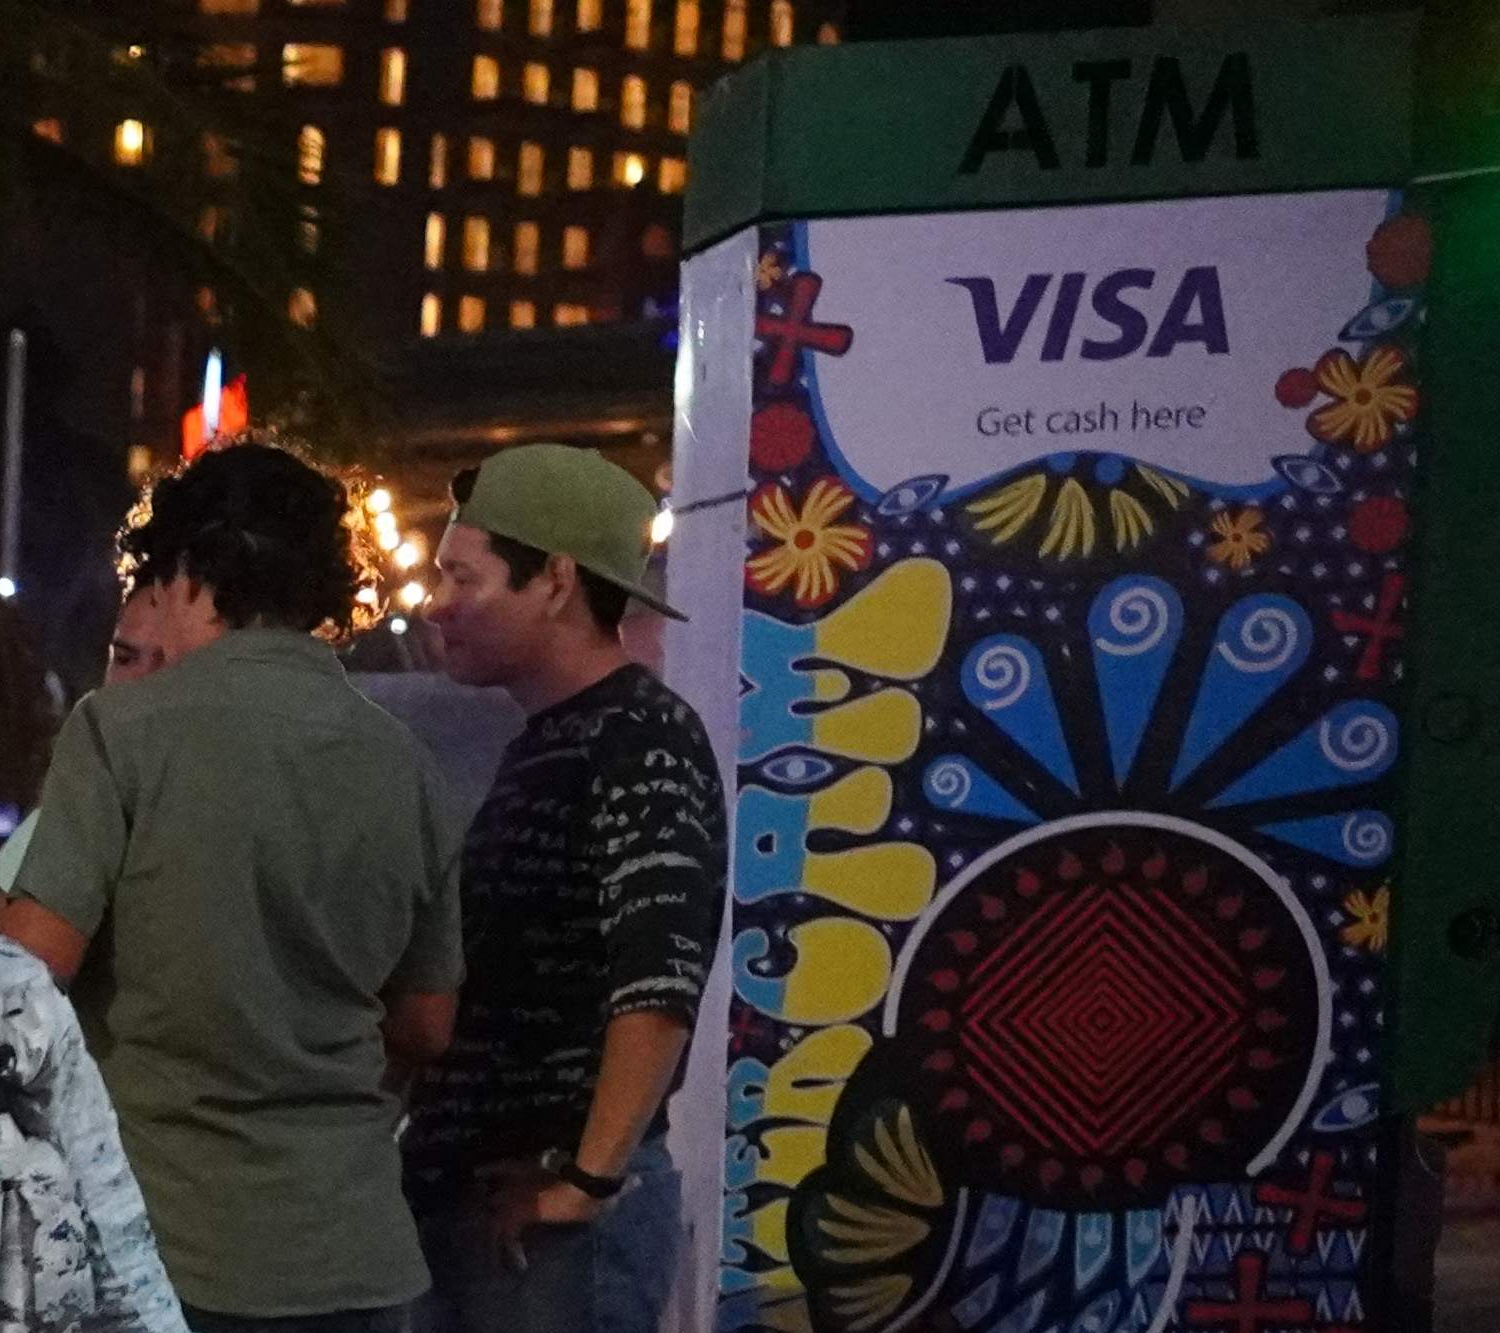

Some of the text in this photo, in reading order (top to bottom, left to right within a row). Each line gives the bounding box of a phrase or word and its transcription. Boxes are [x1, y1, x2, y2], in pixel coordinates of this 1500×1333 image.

[957, 51, 1261, 176] ATM
[944, 265, 1230, 364] VISA
[976, 399, 1206, 437] Get cash here
